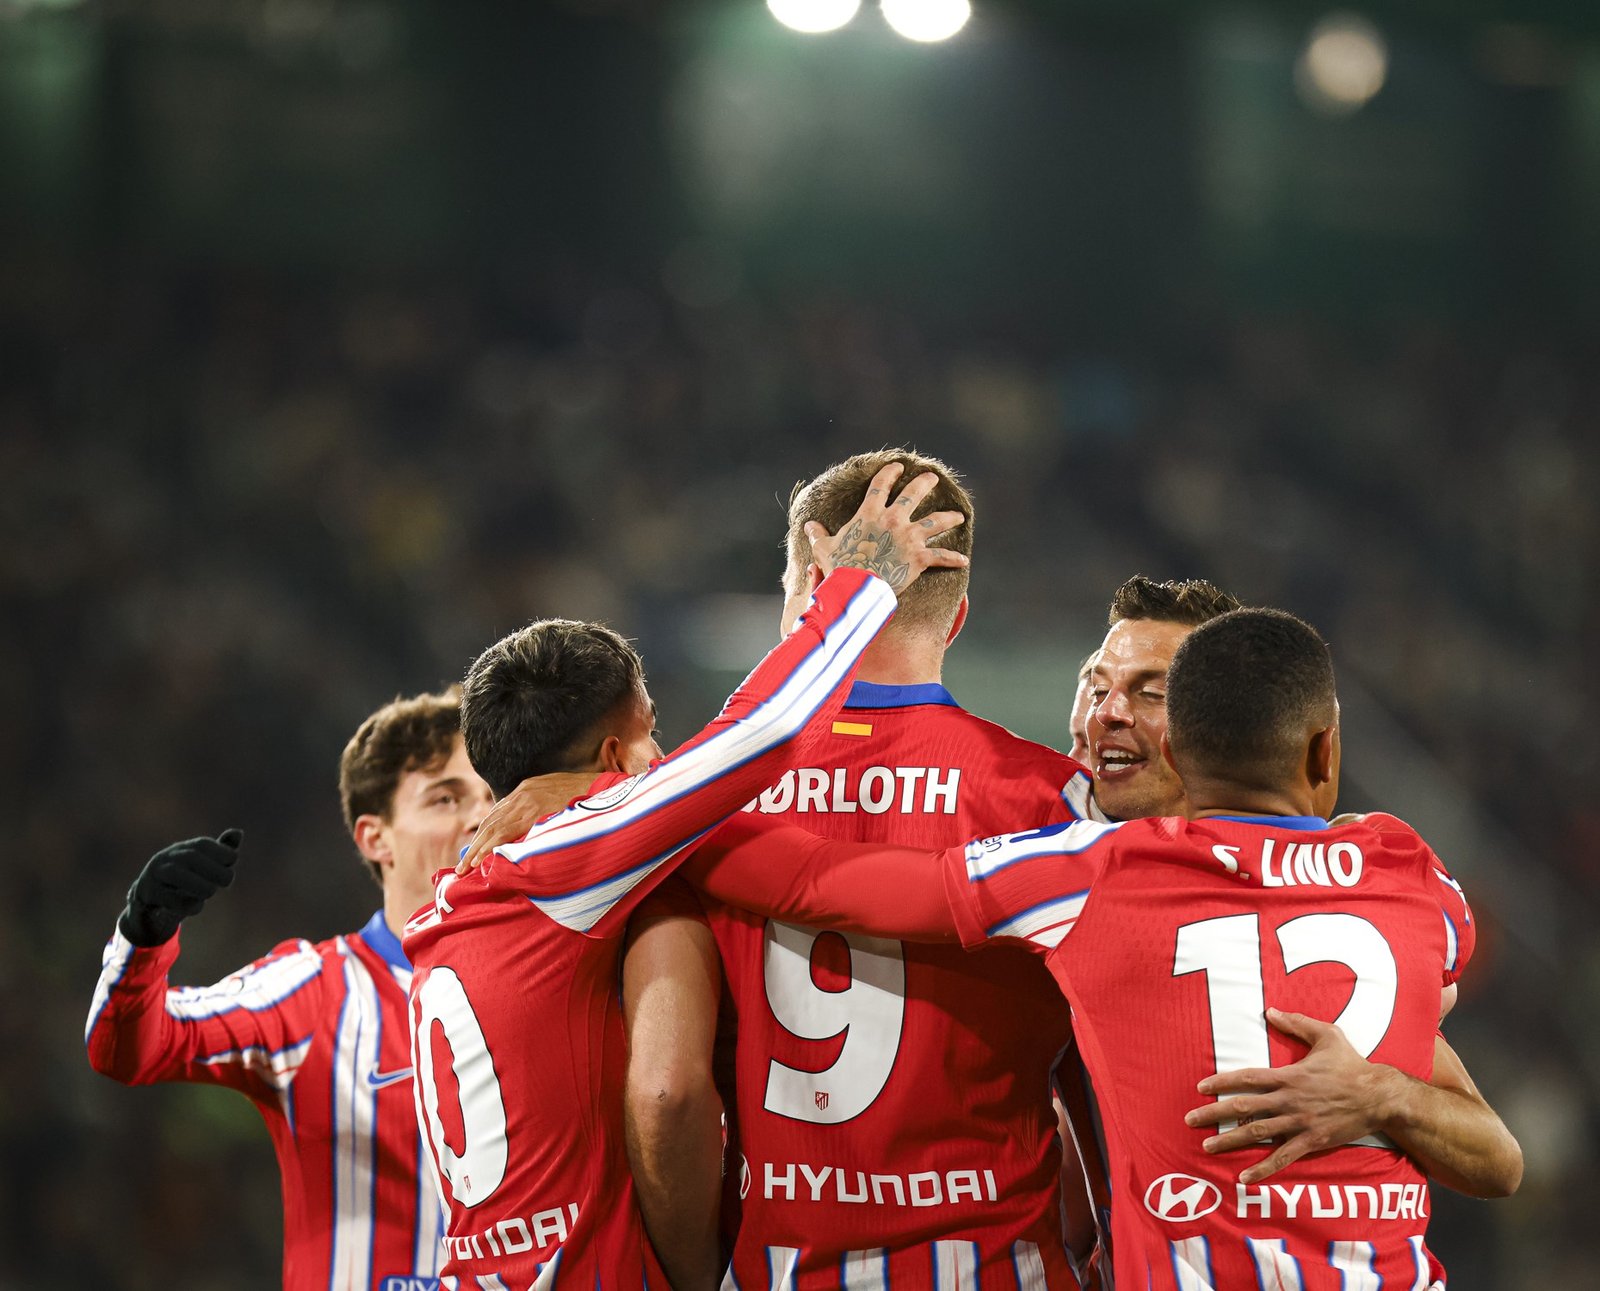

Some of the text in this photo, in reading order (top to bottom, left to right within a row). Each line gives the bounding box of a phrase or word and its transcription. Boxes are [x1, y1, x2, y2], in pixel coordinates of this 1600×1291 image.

[1260, 838, 1364, 888] LINO
[763, 918, 907, 1125] 9
[1171, 912, 1399, 1149] 12
[763, 1162, 998, 1207] HYUNDAI
[1235, 1182, 1429, 1220] HYUNDAI
